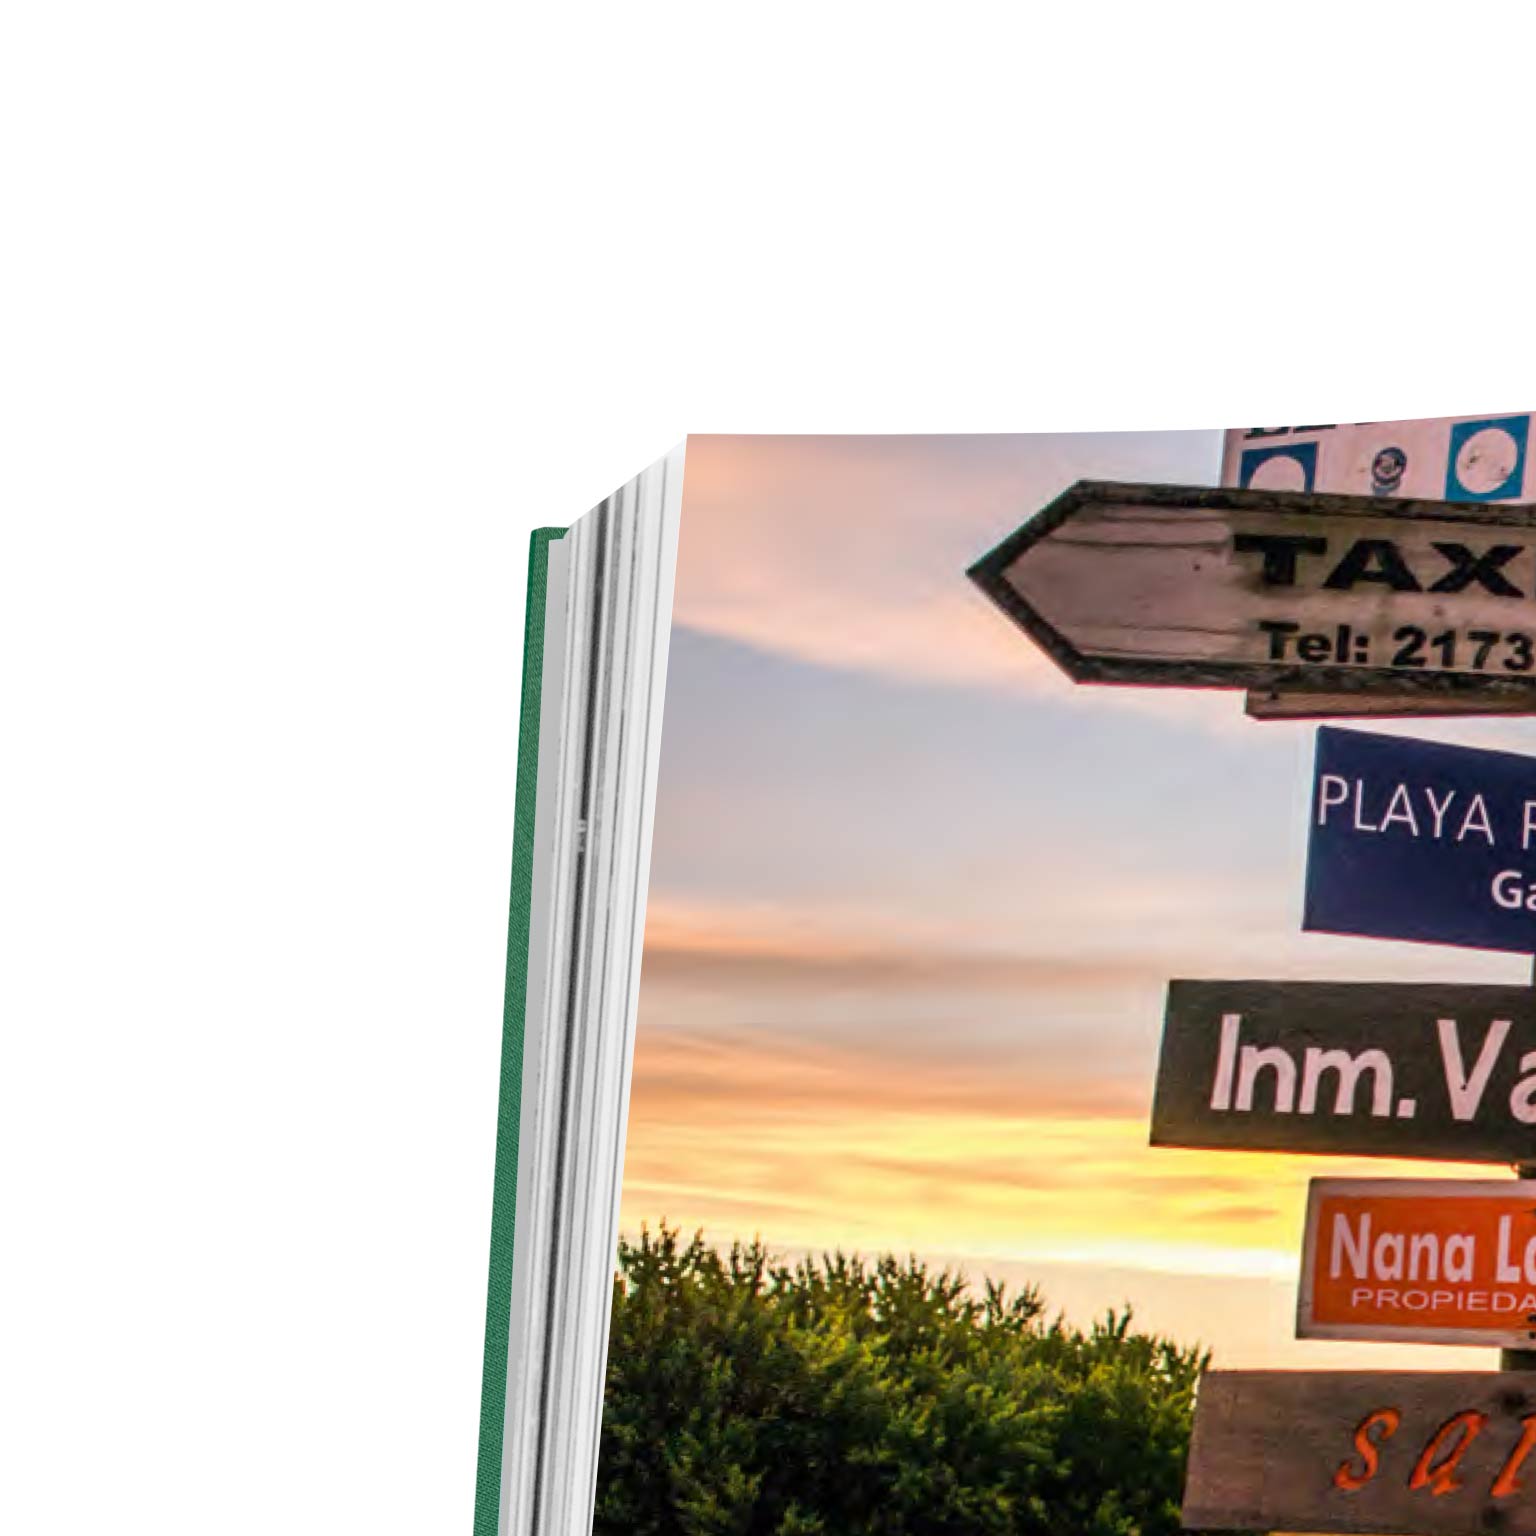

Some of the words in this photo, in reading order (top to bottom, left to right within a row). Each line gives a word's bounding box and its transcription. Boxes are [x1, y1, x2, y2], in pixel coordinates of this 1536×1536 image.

[1257, 620, 1370, 665] Tel:
[1391, 624, 1536, 672] 2173
[1316, 775, 1496, 847] PLAYA
[1210, 1013, 1416, 1119] Inm.
[1329, 1212, 1476, 1281] Nana
